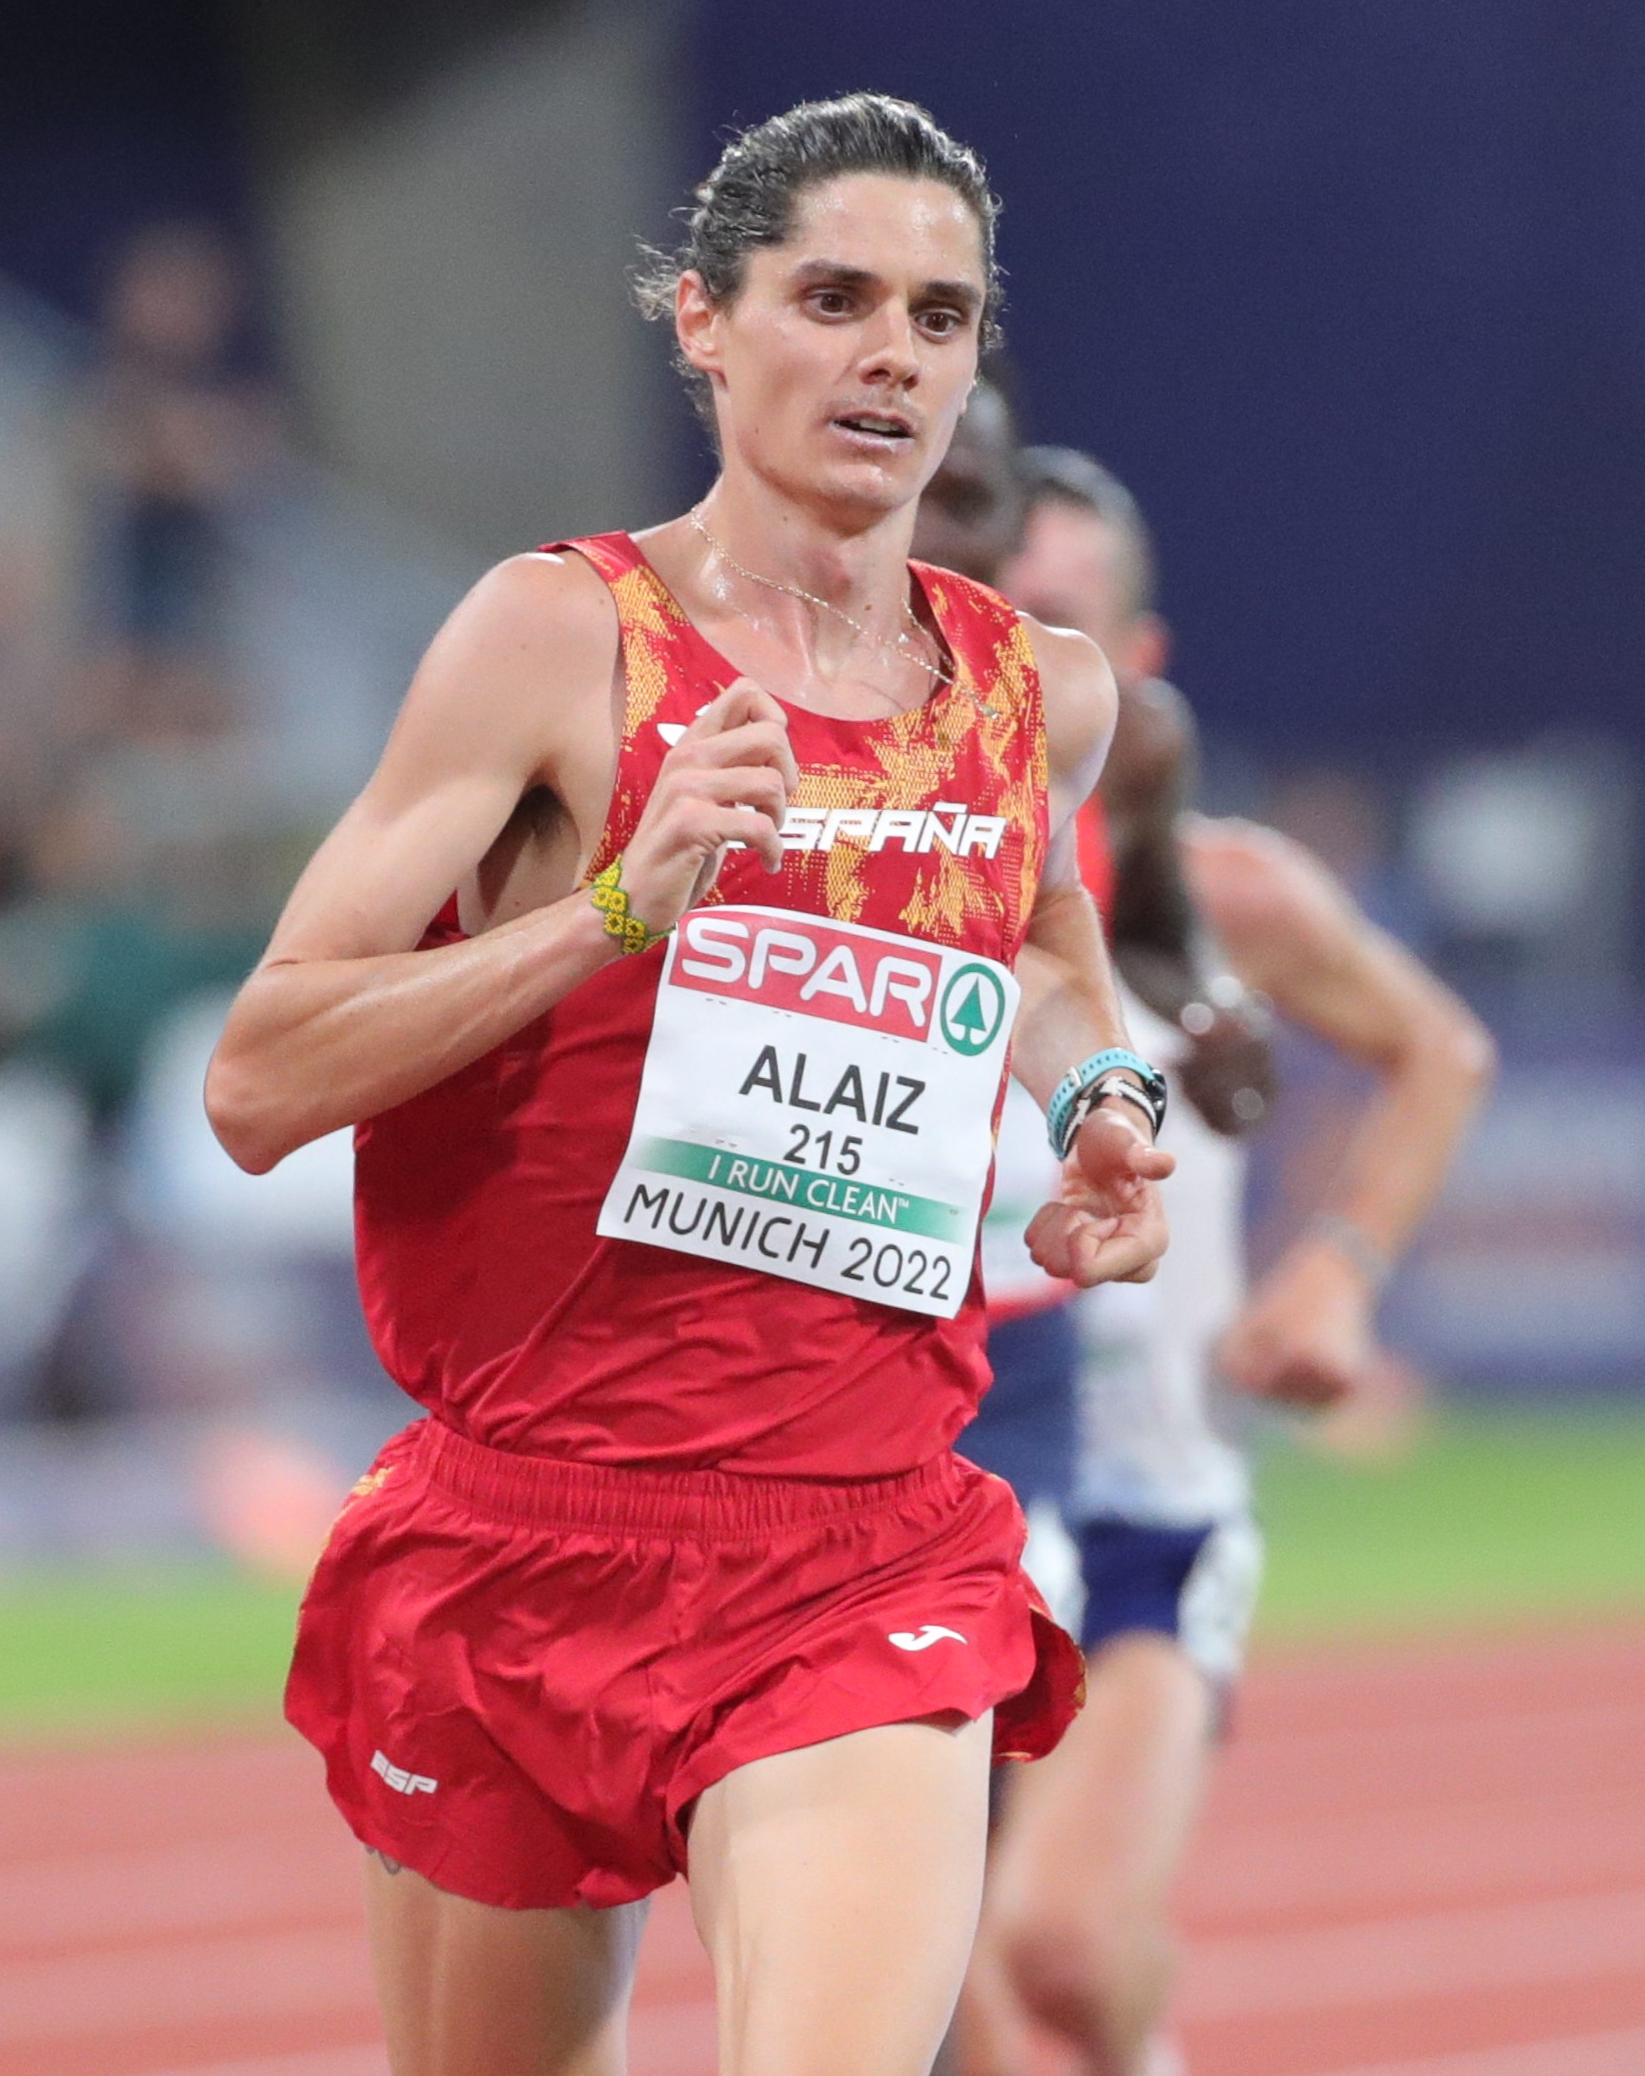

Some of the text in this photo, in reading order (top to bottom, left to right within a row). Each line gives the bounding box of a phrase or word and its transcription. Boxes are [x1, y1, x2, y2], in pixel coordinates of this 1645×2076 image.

[727, 802, 1007, 859] SPAÑA
[681, 917, 933, 1027] SPAR
[738, 1044, 926, 1135] ALAIZ
[708, 1154, 721, 1180] I
[726, 1159, 799, 1200] RUN
[783, 1124, 863, 1176] 215
[624, 1183, 952, 1301] MUNICH 2022
